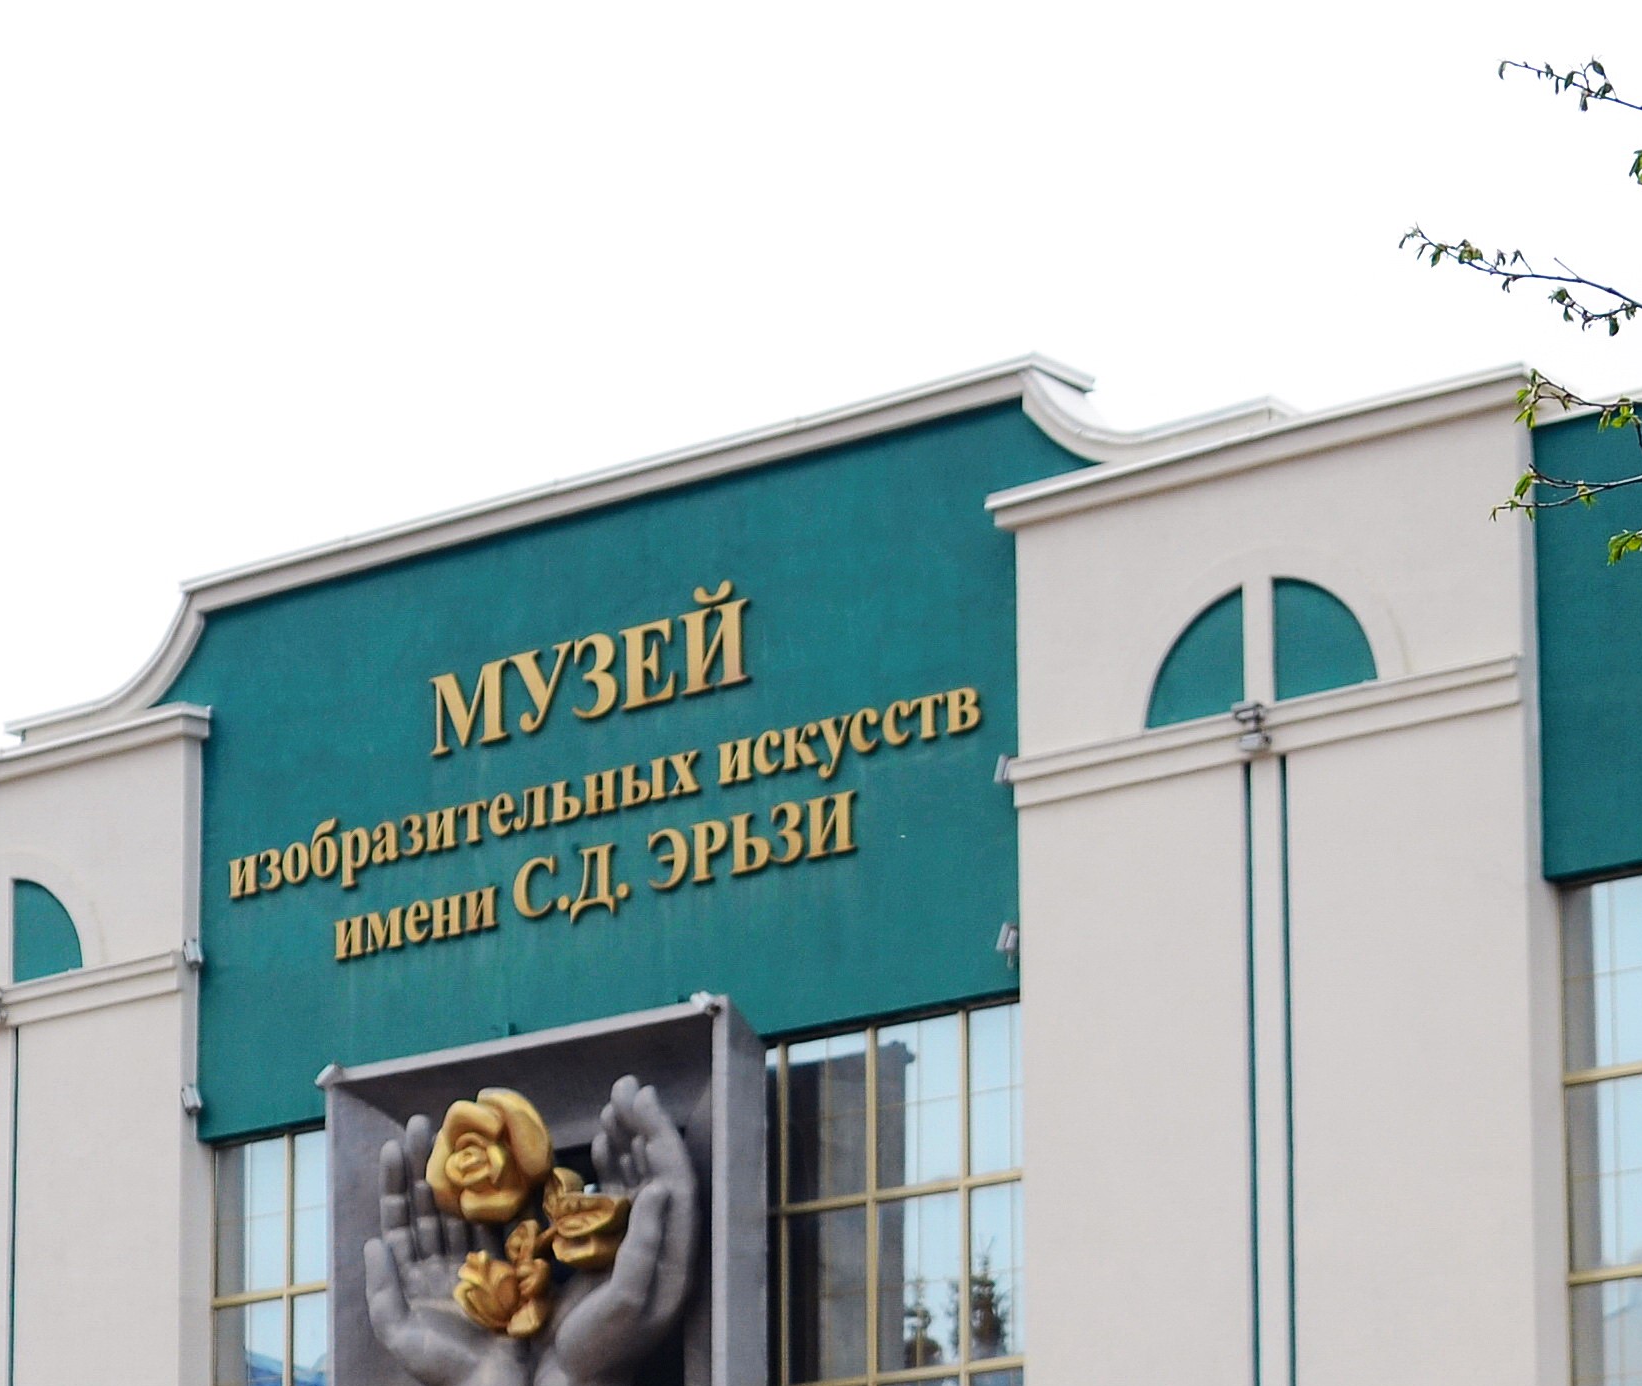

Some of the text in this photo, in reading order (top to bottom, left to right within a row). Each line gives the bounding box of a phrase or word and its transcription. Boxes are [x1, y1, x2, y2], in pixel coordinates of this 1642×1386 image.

[430, 580, 748, 757] МУЗЕЙ
[229, 687, 982, 900] изобразительных искусств
[335, 791, 855, 961] имени С.Д. ЭРЬЗИ
